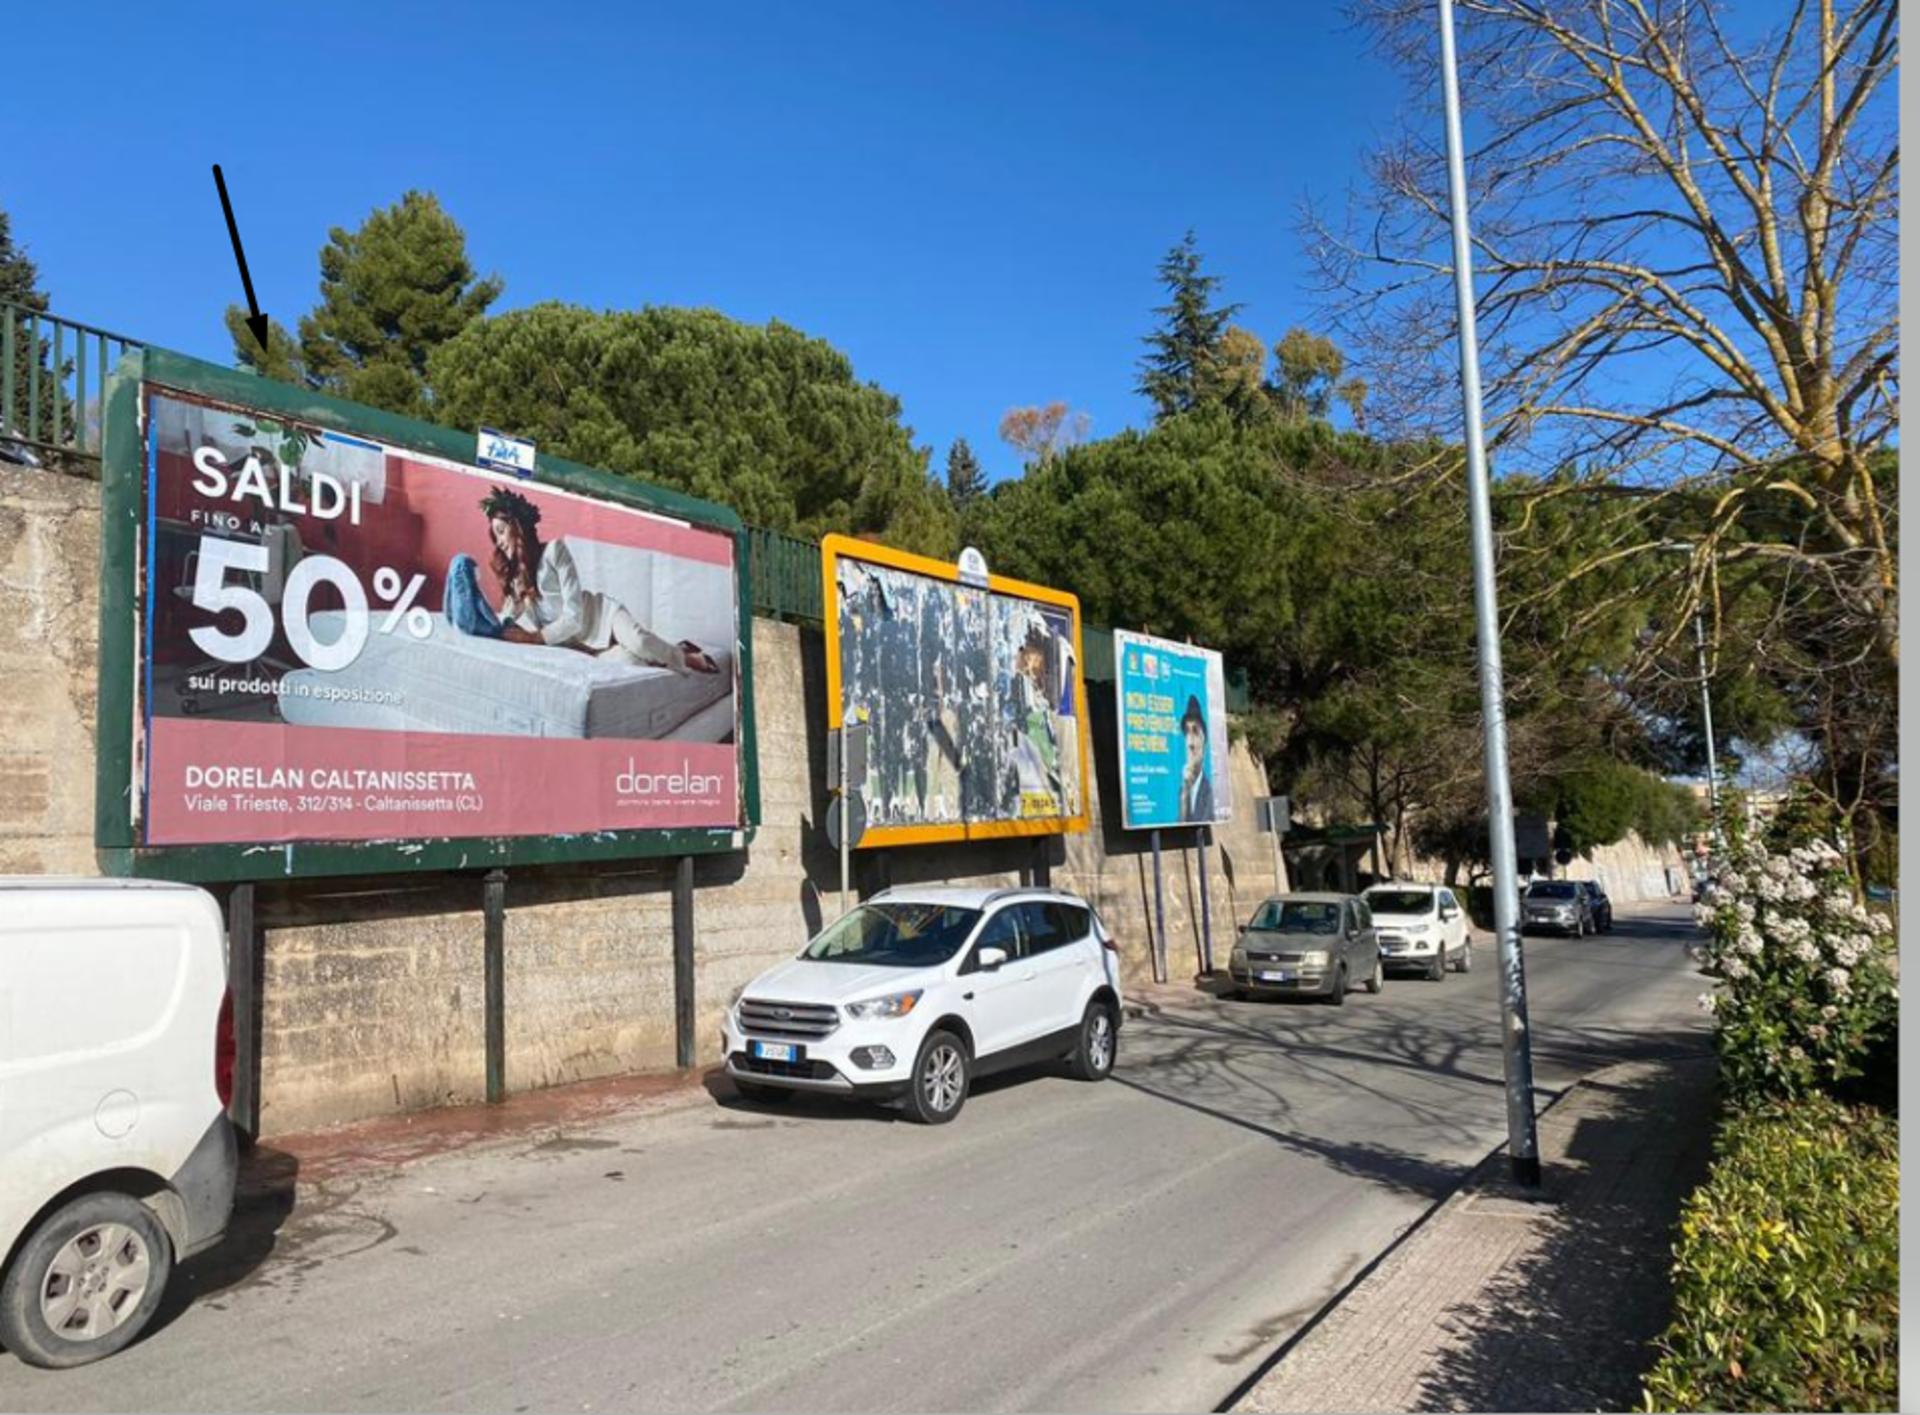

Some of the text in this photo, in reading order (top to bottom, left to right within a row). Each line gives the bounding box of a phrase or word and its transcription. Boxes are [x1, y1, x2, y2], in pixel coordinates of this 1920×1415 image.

[191, 445, 361, 526] SALDI
[190, 509, 241, 530] FINO
[187, 534, 434, 673] 50%
[187, 672, 215, 691] sui
[217, 676, 291, 696] prodotti
[293, 681, 310, 698] in
[184, 765, 477, 792] DORELAN CALTANISSETTA
[616, 756, 722, 795] dorelan
[184, 793, 228, 812] Viale
[231, 793, 293, 814] Trieste,
[296, 794, 352, 813] 312/314
[363, 794, 454, 813] Caltanissetta
[455, 794, 484, 814] (CL)
